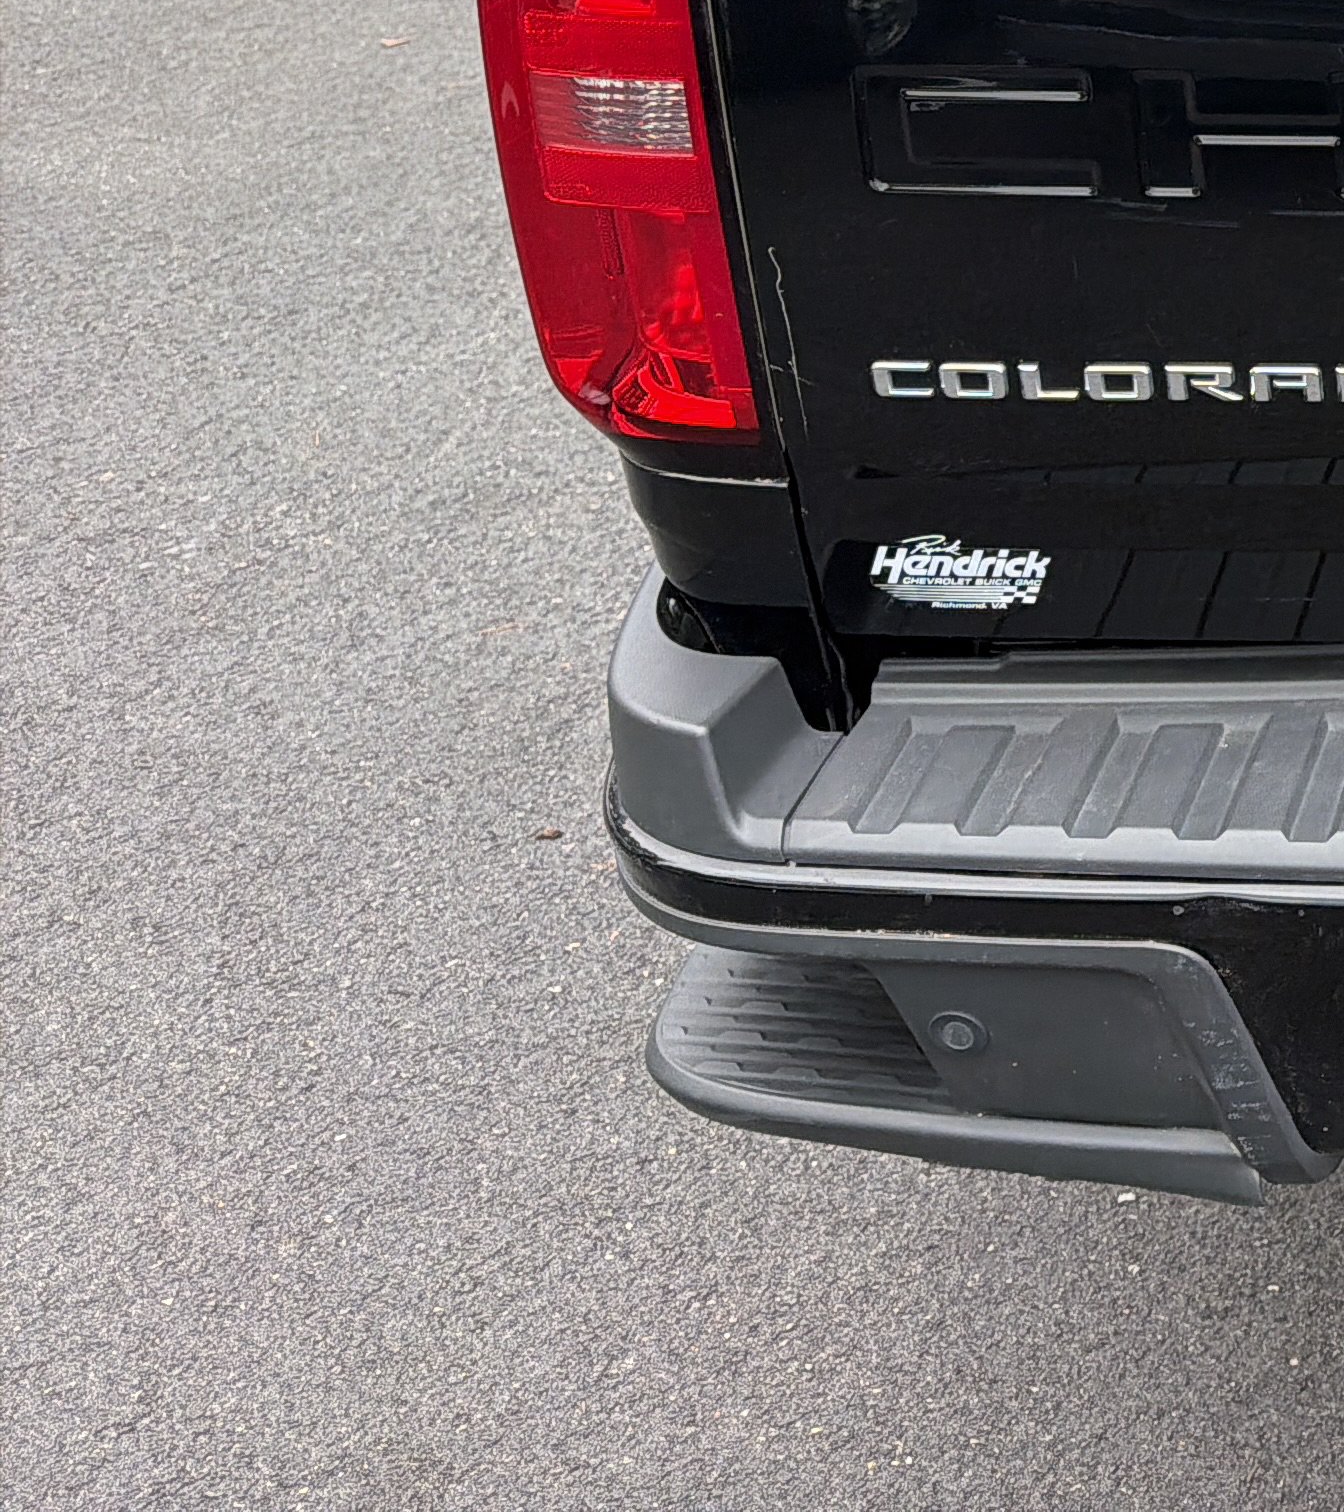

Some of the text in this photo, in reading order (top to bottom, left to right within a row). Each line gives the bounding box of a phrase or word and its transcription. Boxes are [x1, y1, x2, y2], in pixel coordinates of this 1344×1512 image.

[869, 545, 1052, 584] Hendrick
[902, 576, 1043, 587] CHEVROLET BUICK GMC
[991, 601, 1008, 610] VA
